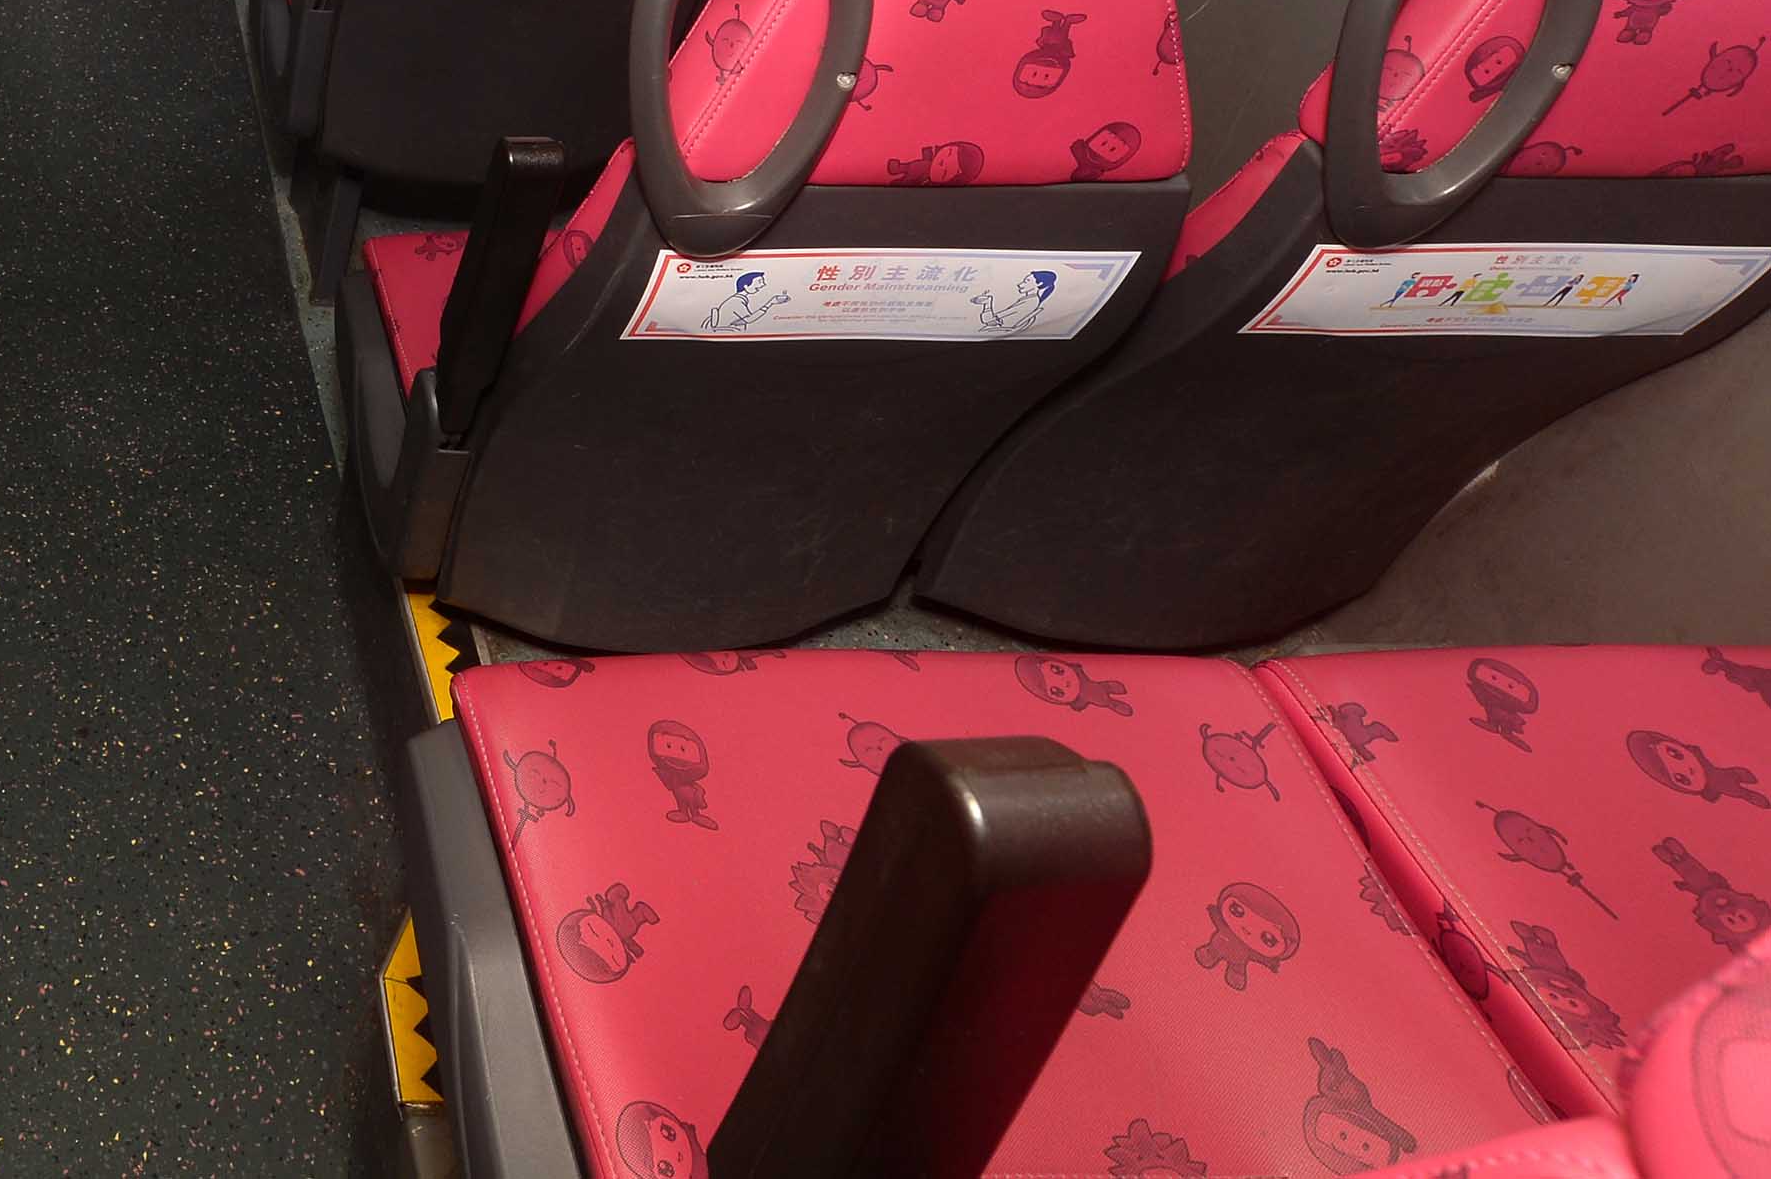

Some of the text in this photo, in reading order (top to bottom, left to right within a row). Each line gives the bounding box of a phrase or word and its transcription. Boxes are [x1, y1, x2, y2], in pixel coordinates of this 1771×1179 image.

[816, 265, 978, 282] 性別主流化
[808, 283, 969, 293] Gender Mainstreaming
